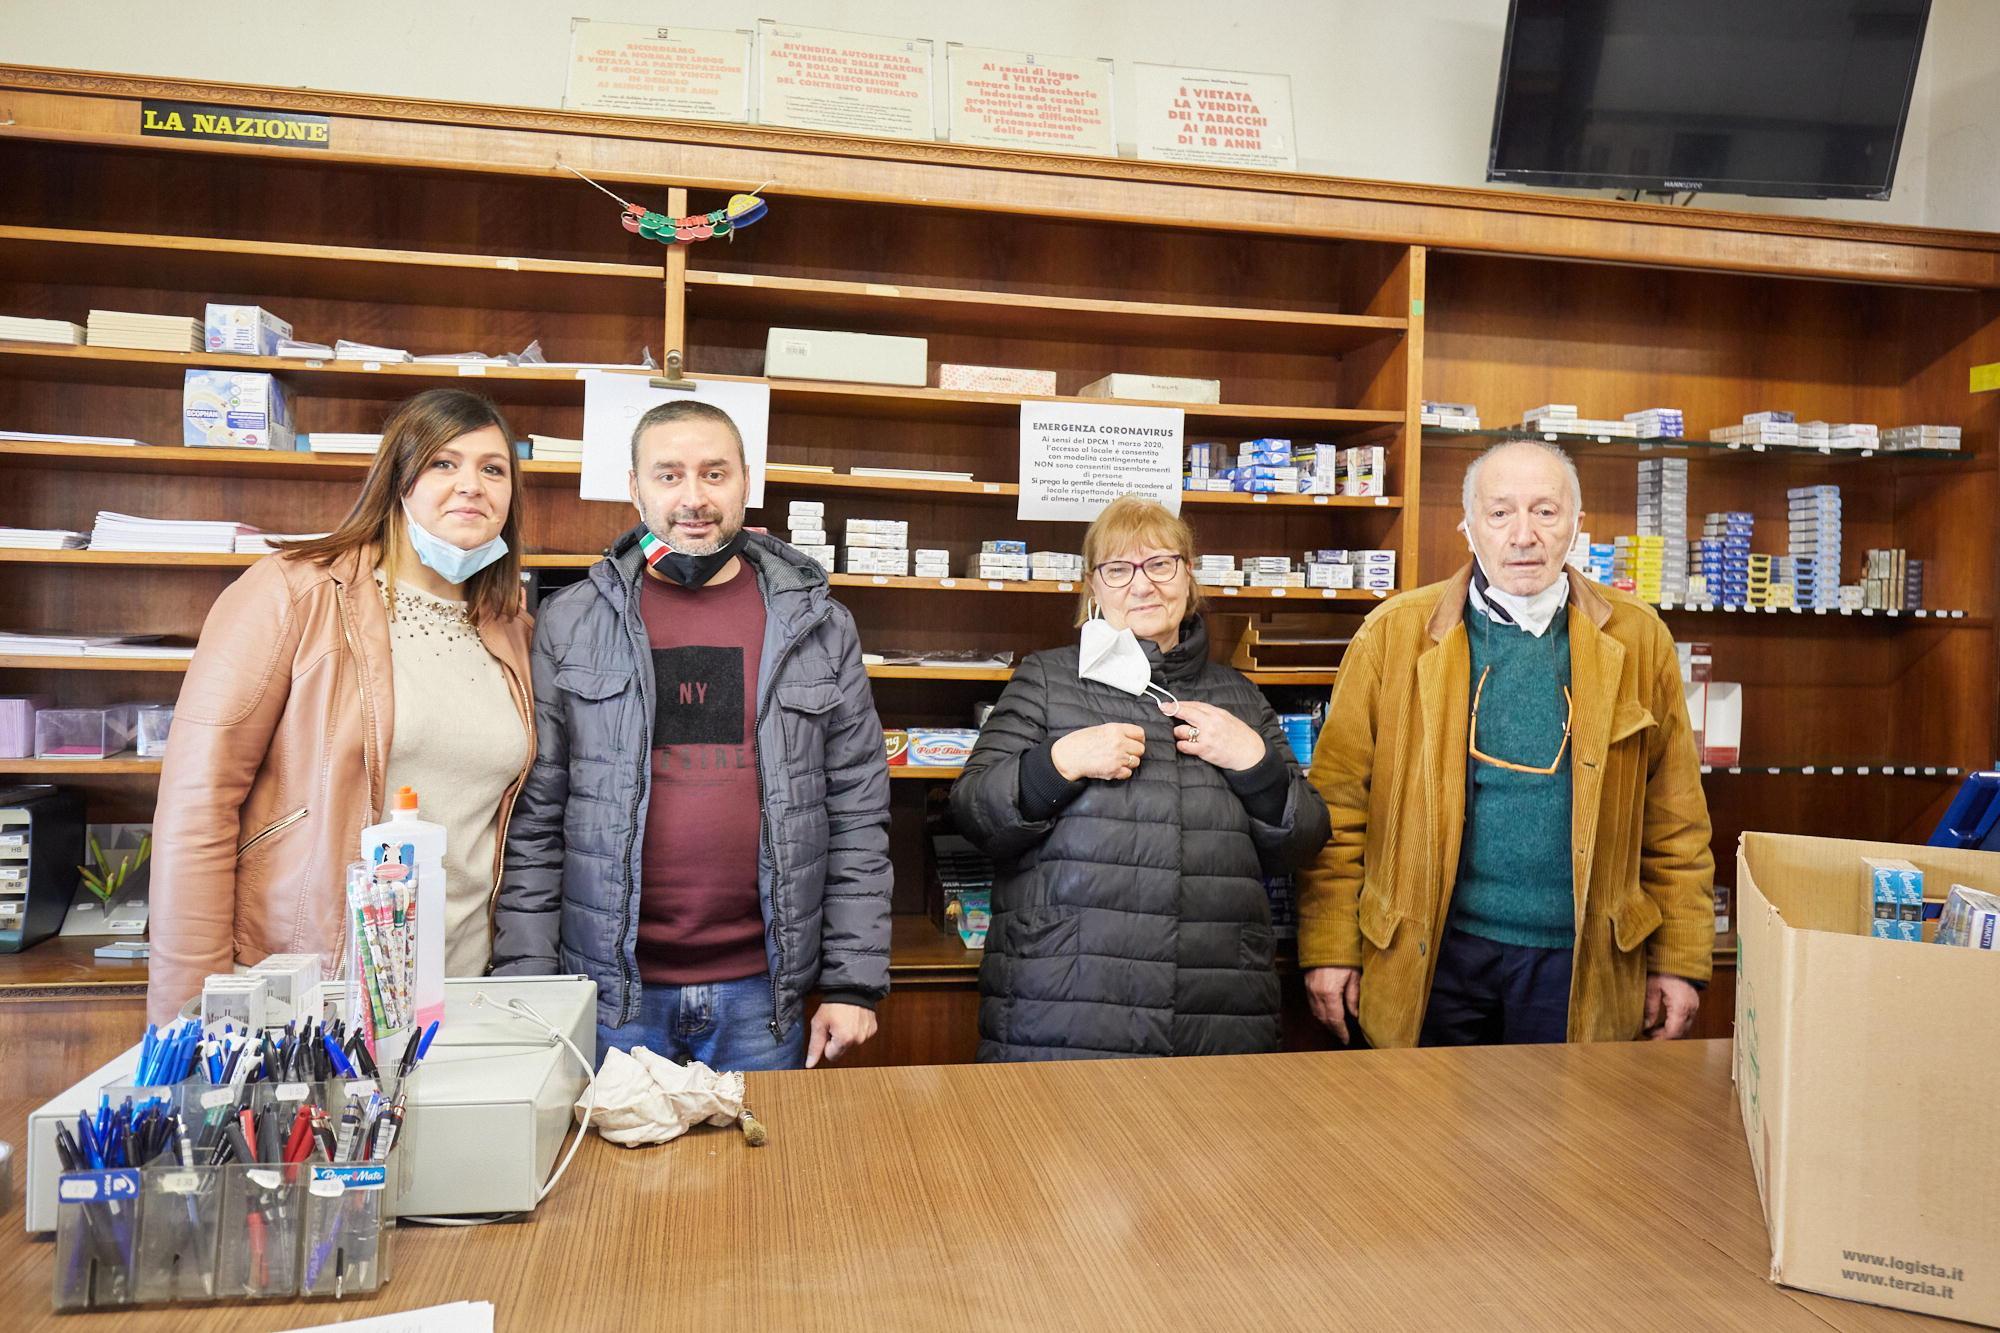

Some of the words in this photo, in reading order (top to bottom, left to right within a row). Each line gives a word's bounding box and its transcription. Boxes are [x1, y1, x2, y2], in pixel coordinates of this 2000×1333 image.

[784, 43, 837, 55] RIVENDITA
[842, 50, 911, 64] AUTORIZZATA
[806, 63, 838, 73] BOLLO
[842, 67, 908, 81] TELEMATICHE
[852, 59, 879, 69] DELLE
[884, 63, 923, 74] MARCHE
[1000, 66, 1028, 74] sensi
[1033, 67, 1043, 75] di
[1048, 69, 1080, 81] legge
[806, 71, 830, 80] ALLA
[834, 75, 900, 88] RISCOSSIONE
[1013, 75, 1061, 86] VIETATO
[800, 79, 863, 92] CONTRIBUTO
[866, 87, 919, 98] UNIFICATO
[1015, 83, 1025, 91] in
[1030, 85, 1097, 99] tabaccheria
[1180, 86, 1187, 97] È
[1193, 89, 1252, 102] VIETATA
[1174, 99, 1191, 109] LA
[1198, 101, 1260, 114] VENDITA
[144, 110, 185, 132] LA
[193, 113, 328, 142] NAZIONE
[996, 117, 1083, 132] riconoscimento
[1168, 111, 1191, 120] DEI
[1198, 113, 1268, 127] TABACCHI
[993, 126, 1023, 135] della
[1028, 130, 1074, 140] persona
[1183, 124, 1199, 133] AI
[1205, 126, 1260, 138] MINORI
[1178, 135, 1193, 144] DI
[1201, 137, 1217, 146] 18
[1225, 140, 1262, 150] ANNI
[1033, 423, 1096, 433] EMERGENZA
[1100, 426, 1174, 437] CORONAVIRUS
[1047, 445, 1079, 453] l'accesso
[1122, 449, 1159, 457] consentito
[1144, 441, 1164, 449] 2020,
[1100, 456, 1150, 464] contingentate
[1076, 463, 1111, 471] consentiti
[1114, 465, 1170, 473] assembramenti
[1072, 488, 1114, 496] rispettando
[680, 682, 708, 704] NY
[1983, 918, 1994, 947] MURATTI
[357, 1170, 383, 1181] Mate
[1842, 1250, 1964, 1281] www.logista.it
[1841, 1268, 1955, 1299] www.terzia.it
